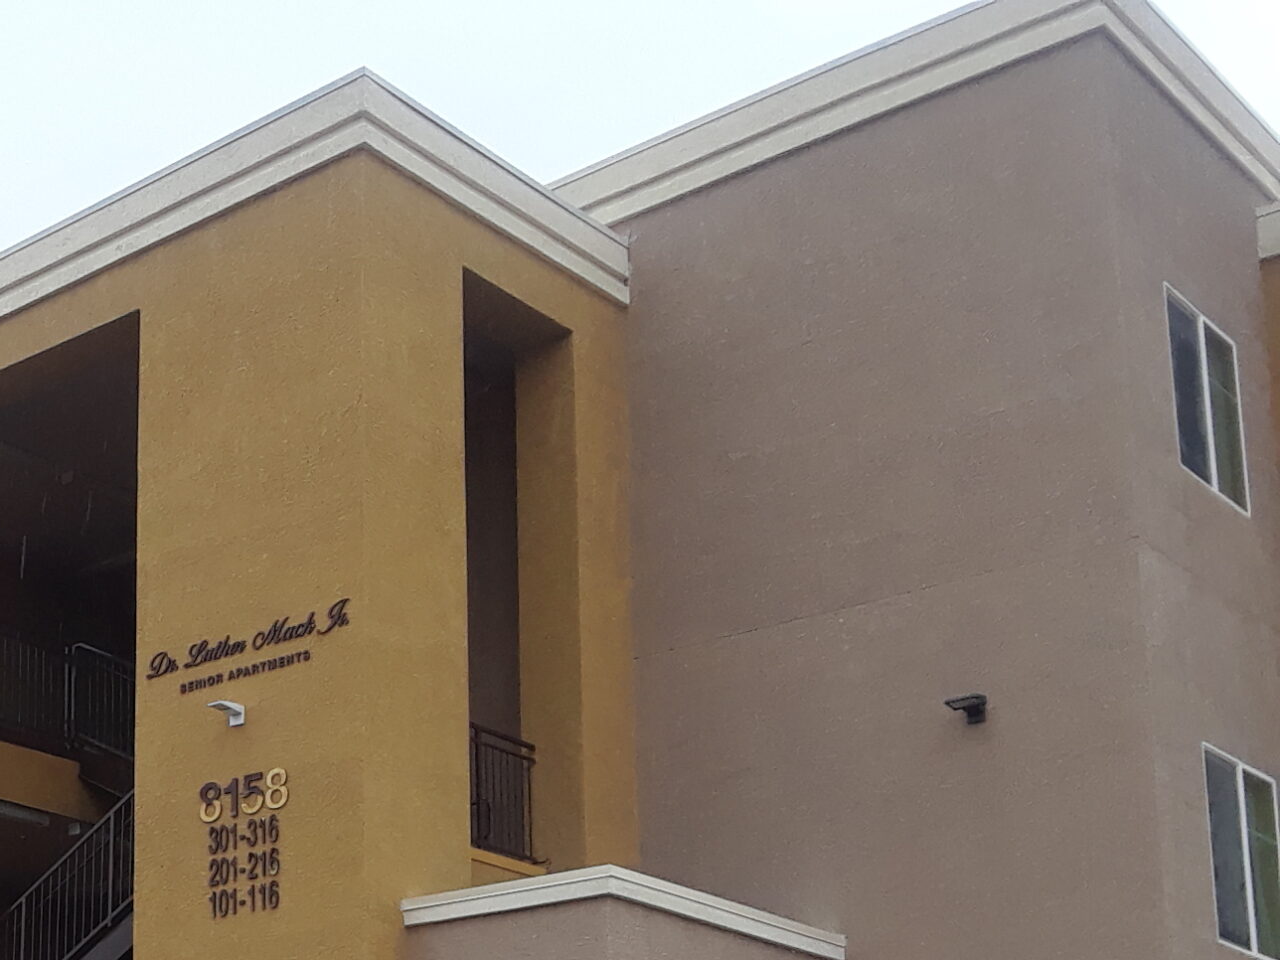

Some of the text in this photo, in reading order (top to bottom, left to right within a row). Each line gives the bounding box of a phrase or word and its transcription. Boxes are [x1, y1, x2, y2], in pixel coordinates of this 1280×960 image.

[146, 598, 350, 680] Dr. Luther Mack Jr.
[180, 650, 311, 695] SENIOR APARTMENTS
[200, 767, 288, 822] 8158
[208, 814, 279, 855] 301-316
[208, 847, 280, 887] 201-216
[208, 880, 279, 918] 101-116
